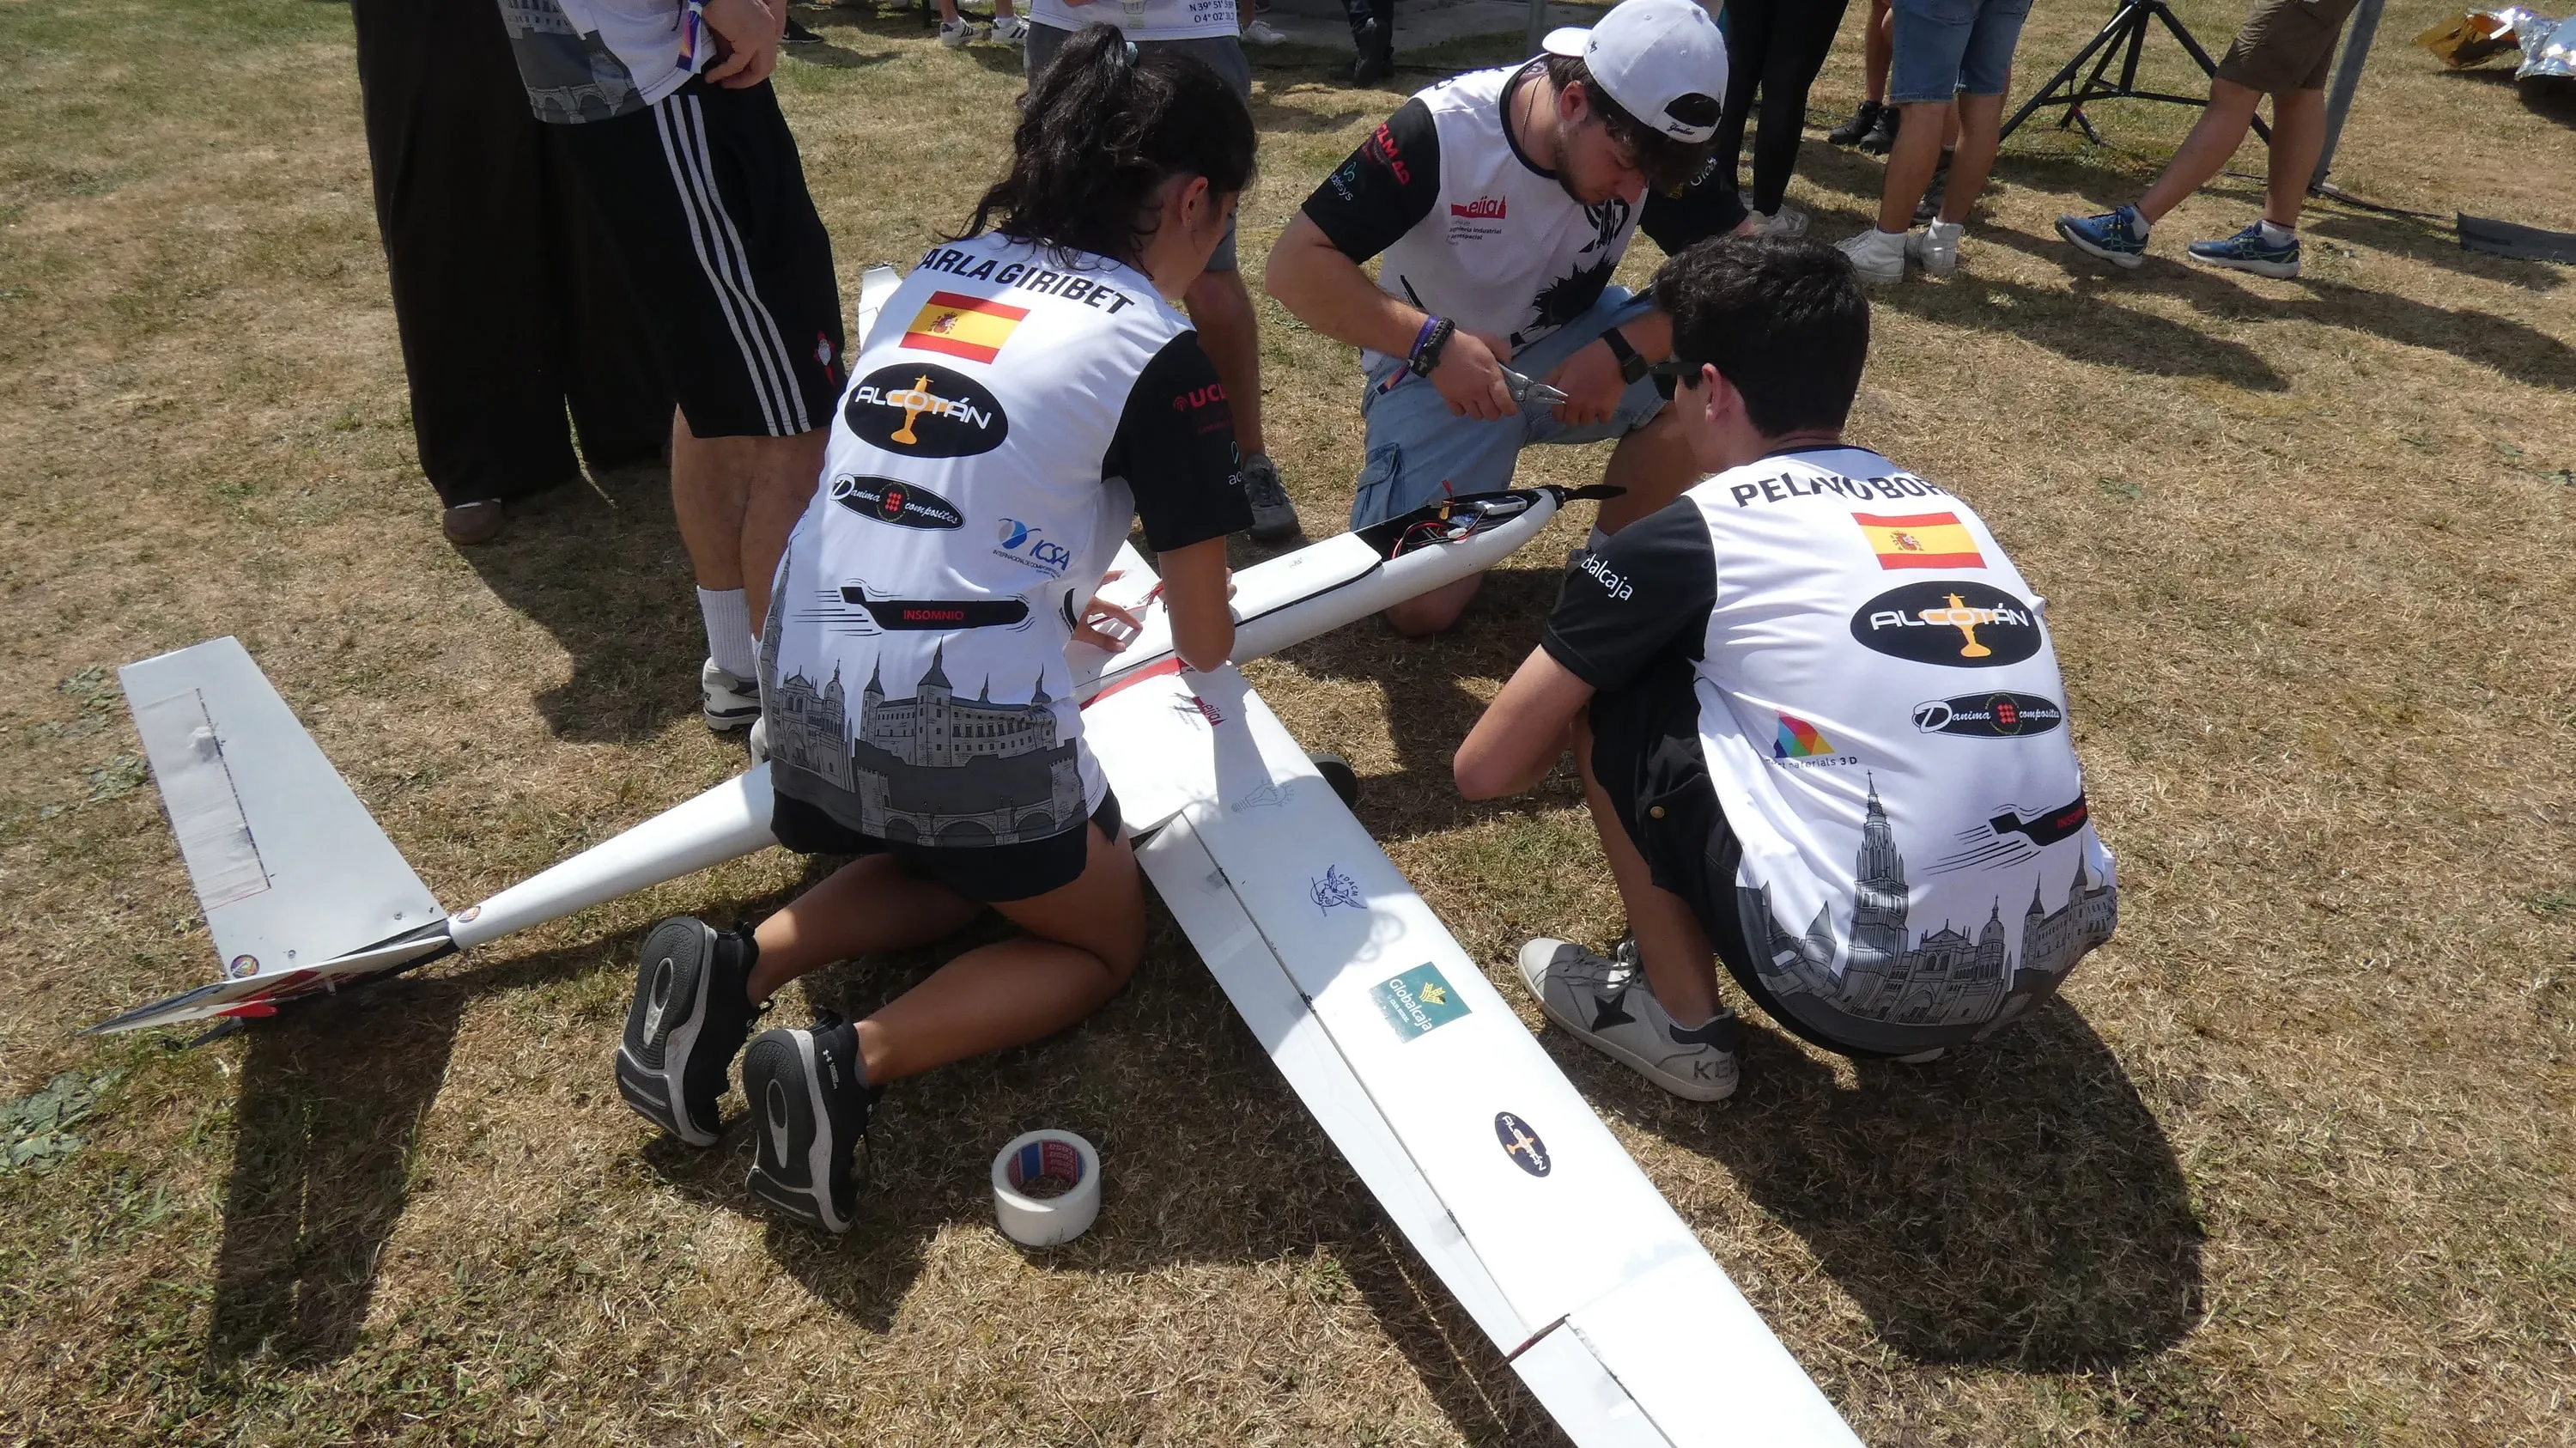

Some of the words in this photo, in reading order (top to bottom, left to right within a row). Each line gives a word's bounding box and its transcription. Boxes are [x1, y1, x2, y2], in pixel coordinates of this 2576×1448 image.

[917, 248, 999, 281] ARLA
[994, 264, 1135, 314] GIRIBET
[855, 386, 992, 429] ALCOTÁN
[830, 473, 881, 502] Danima
[904, 502, 959, 525] composites
[1029, 539, 1070, 571] ICSA
[903, 609, 965, 621] INSOMNIO
[1870, 603, 2029, 630] ALCOTÁN
[1913, 700, 1992, 733] Danima
[1389, 978, 1433, 1031] Globalcaja
